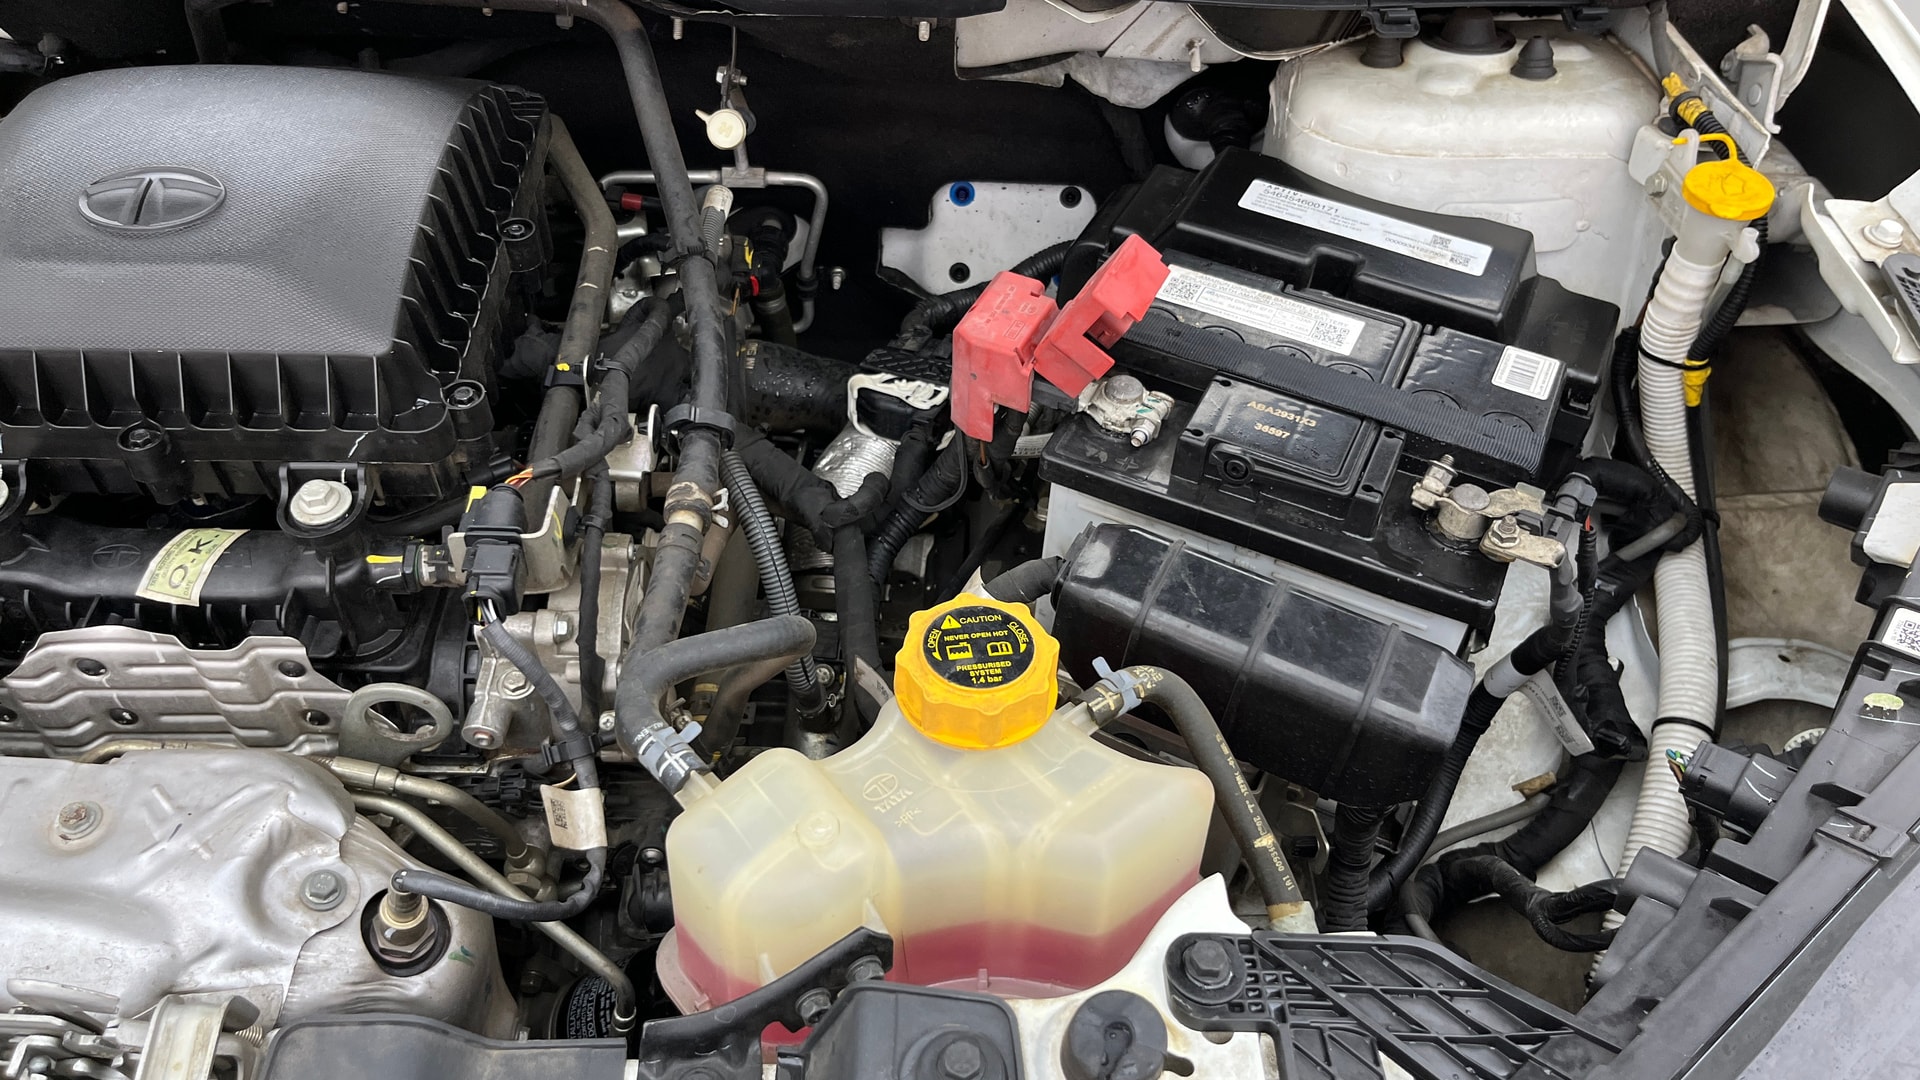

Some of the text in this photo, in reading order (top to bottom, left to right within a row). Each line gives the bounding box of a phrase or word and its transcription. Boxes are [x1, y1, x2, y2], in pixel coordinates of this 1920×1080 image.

[184, 580, 194, 596] DATE
[960, 614, 1002, 624] CAUTION
[927, 628, 940, 648] OPEN
[944, 630, 1008, 642] NEVER OPEN HOT
[1009, 621, 1029, 644] CLOSE
[956, 660, 1012, 672] PRESSURISED
[970, 668, 1002, 676] SYSTEM
